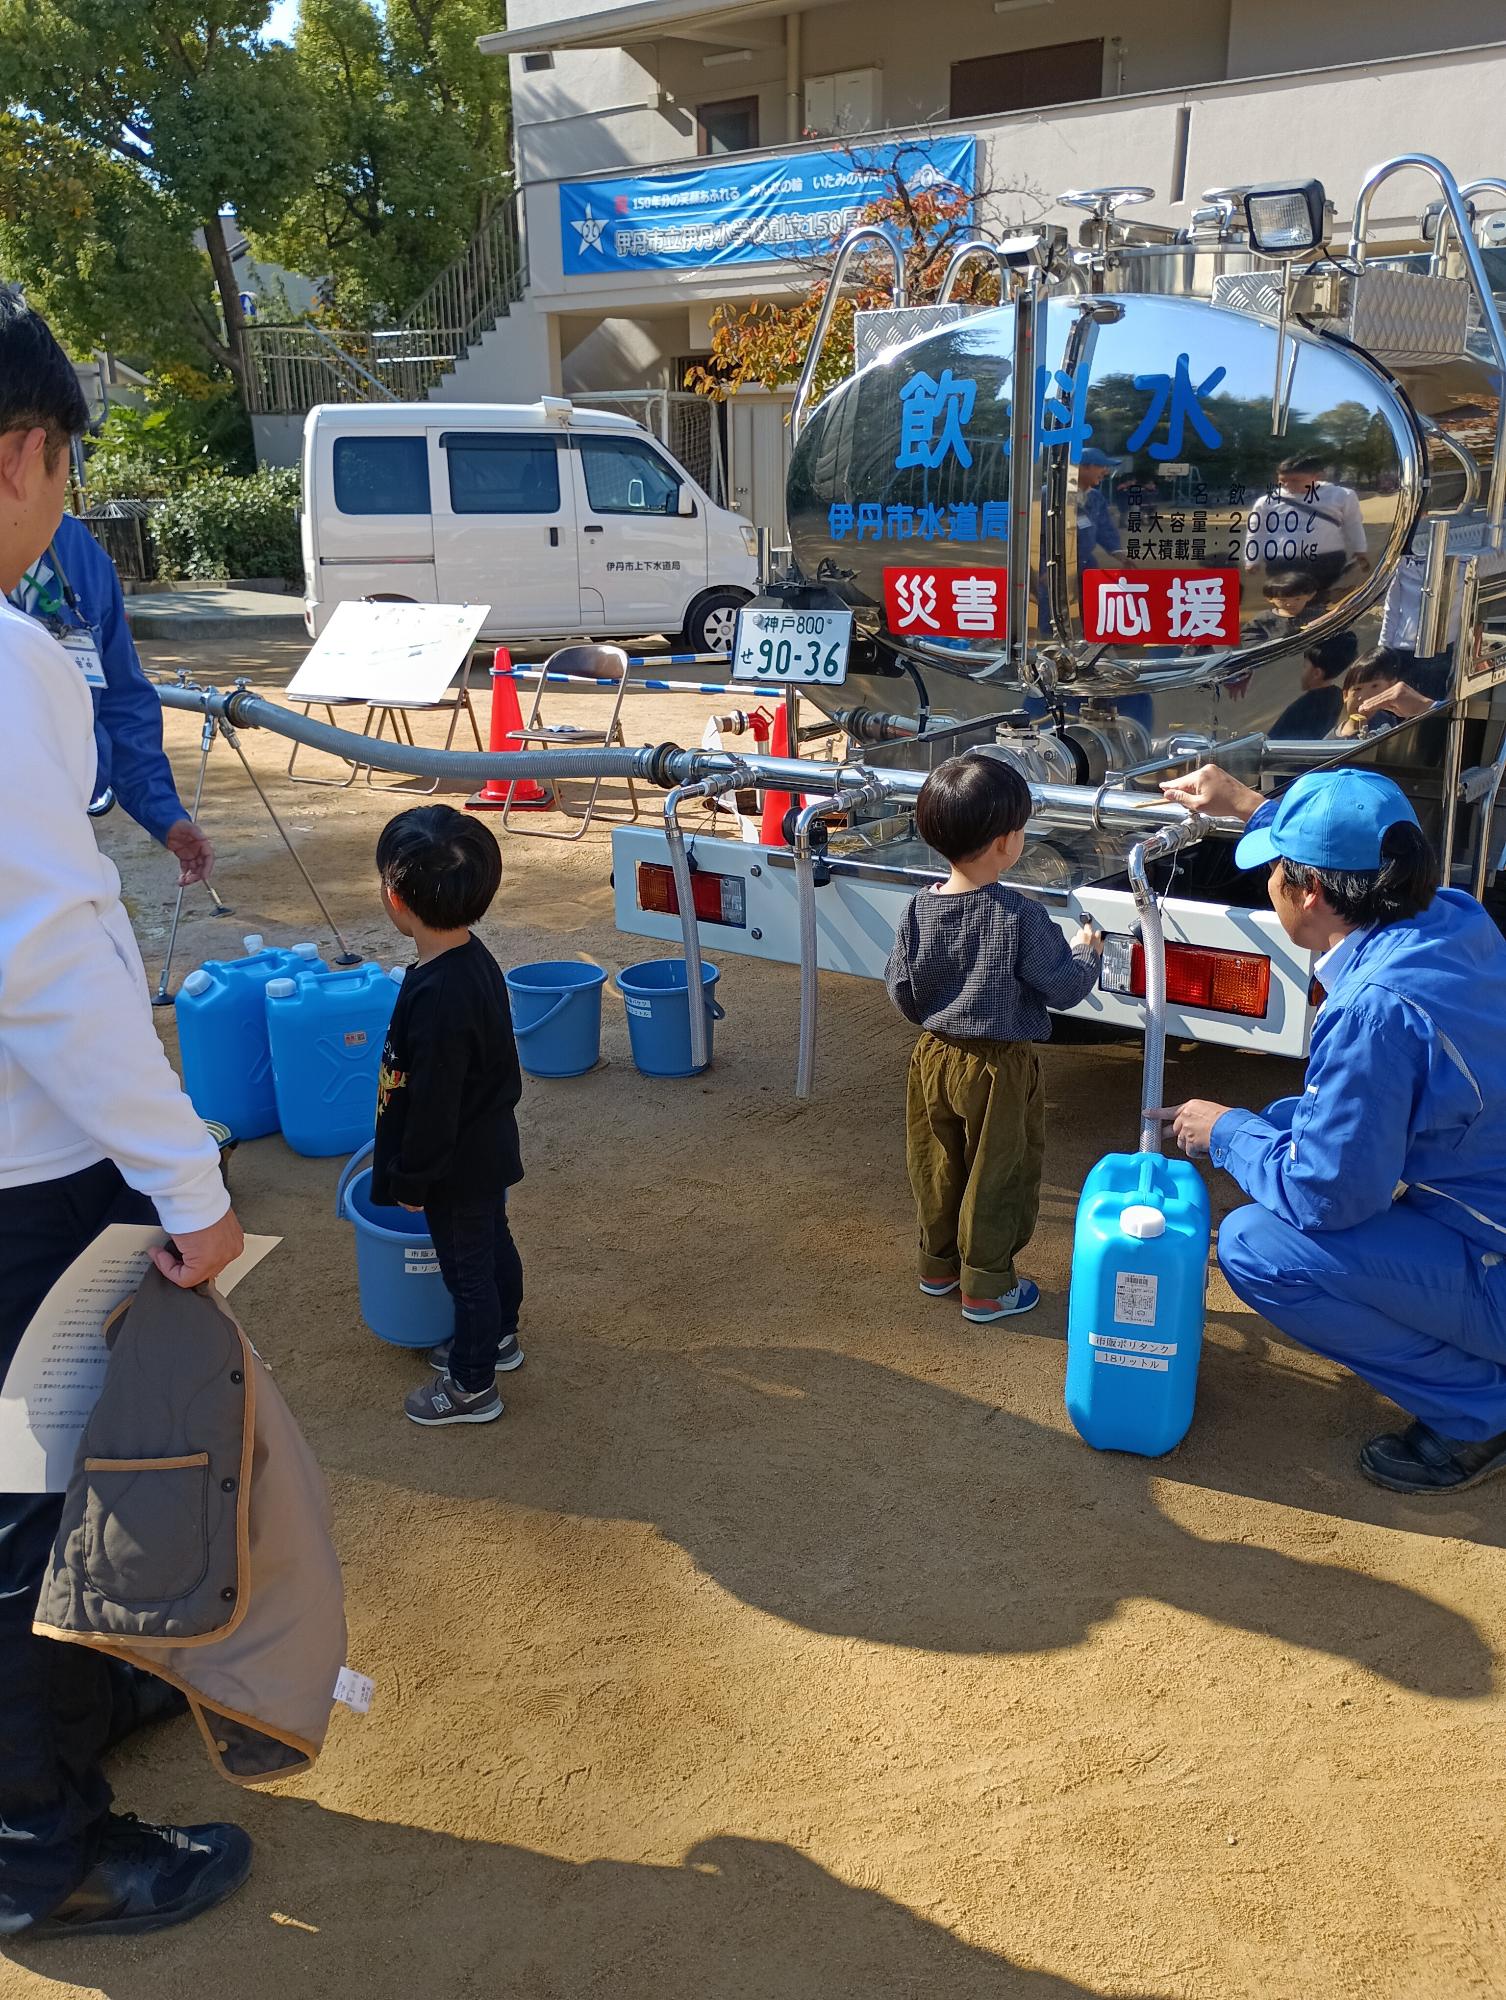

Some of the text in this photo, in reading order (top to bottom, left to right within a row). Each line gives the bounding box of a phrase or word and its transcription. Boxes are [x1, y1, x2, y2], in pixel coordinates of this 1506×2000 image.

[828, 502, 1008, 541] 伊丹市水道局
[606, 561, 680, 571] 伊丹市上下水道局
[895, 574, 998, 631] 災害
[1096, 576, 1226, 638] 応援
[757, 639, 841, 677] 90-36
[1096, 1336, 1169, 1354] 市販ポリタンク
[1104, 1353, 1160, 1369] 18リットル
